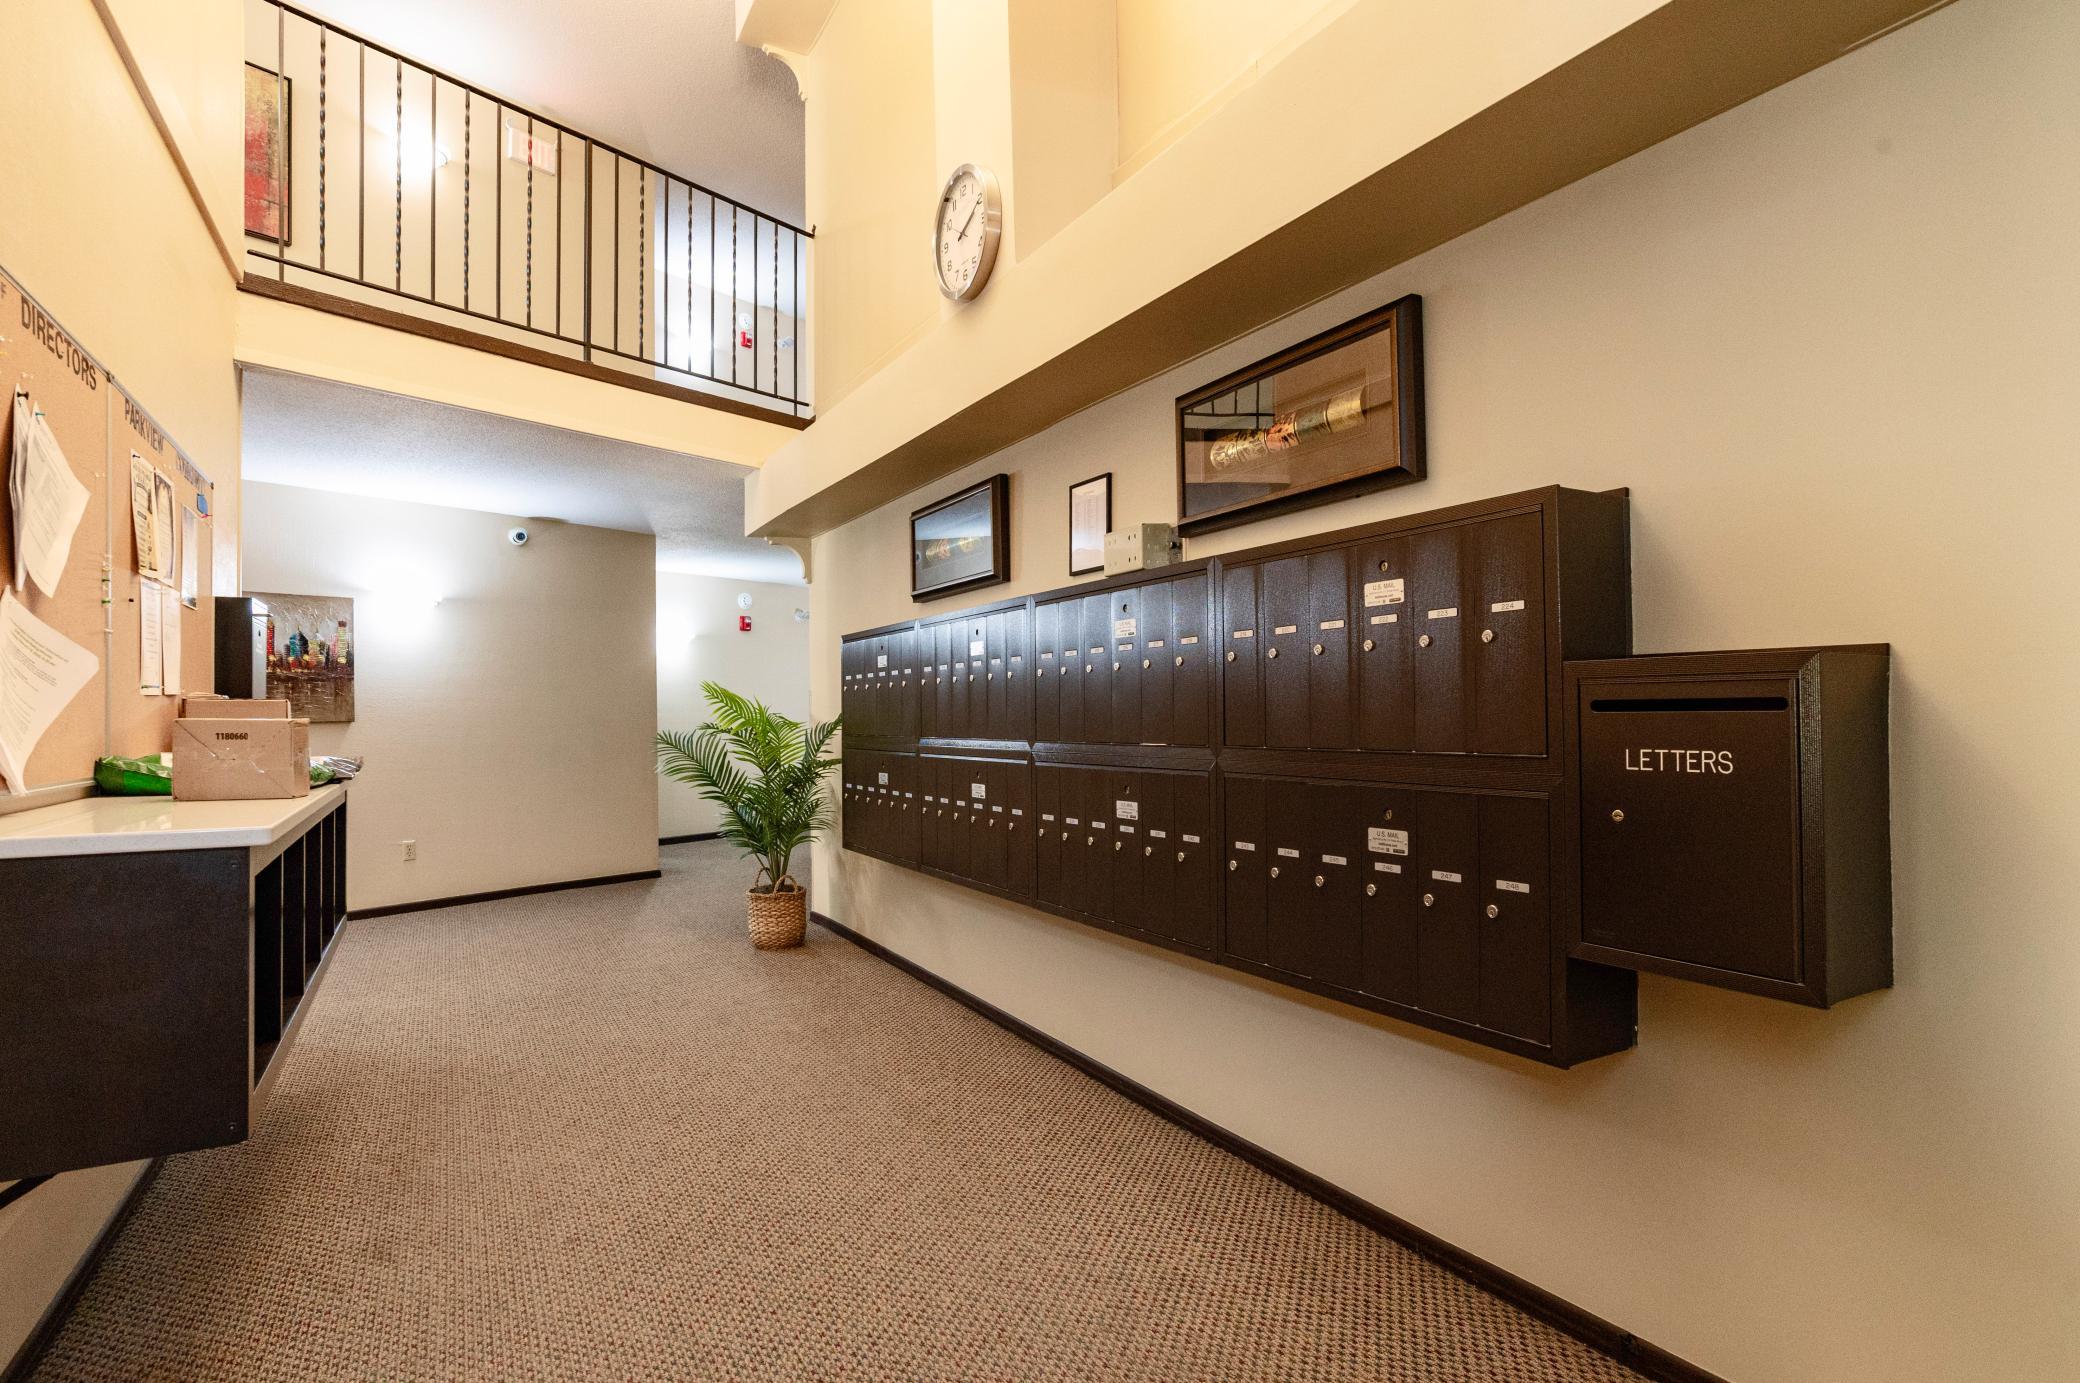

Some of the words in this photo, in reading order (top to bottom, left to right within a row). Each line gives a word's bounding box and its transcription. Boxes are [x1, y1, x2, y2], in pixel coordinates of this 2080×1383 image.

[21, 294, 96, 390] DIRECTORS
[125, 397, 164, 456] PARKVIEW
[1501, 602, 1514, 610] 224
[215, 732, 249, 741] 1180660
[1625, 748, 1734, 775] LETTERS
[1505, 882, 1520, 891] 248
